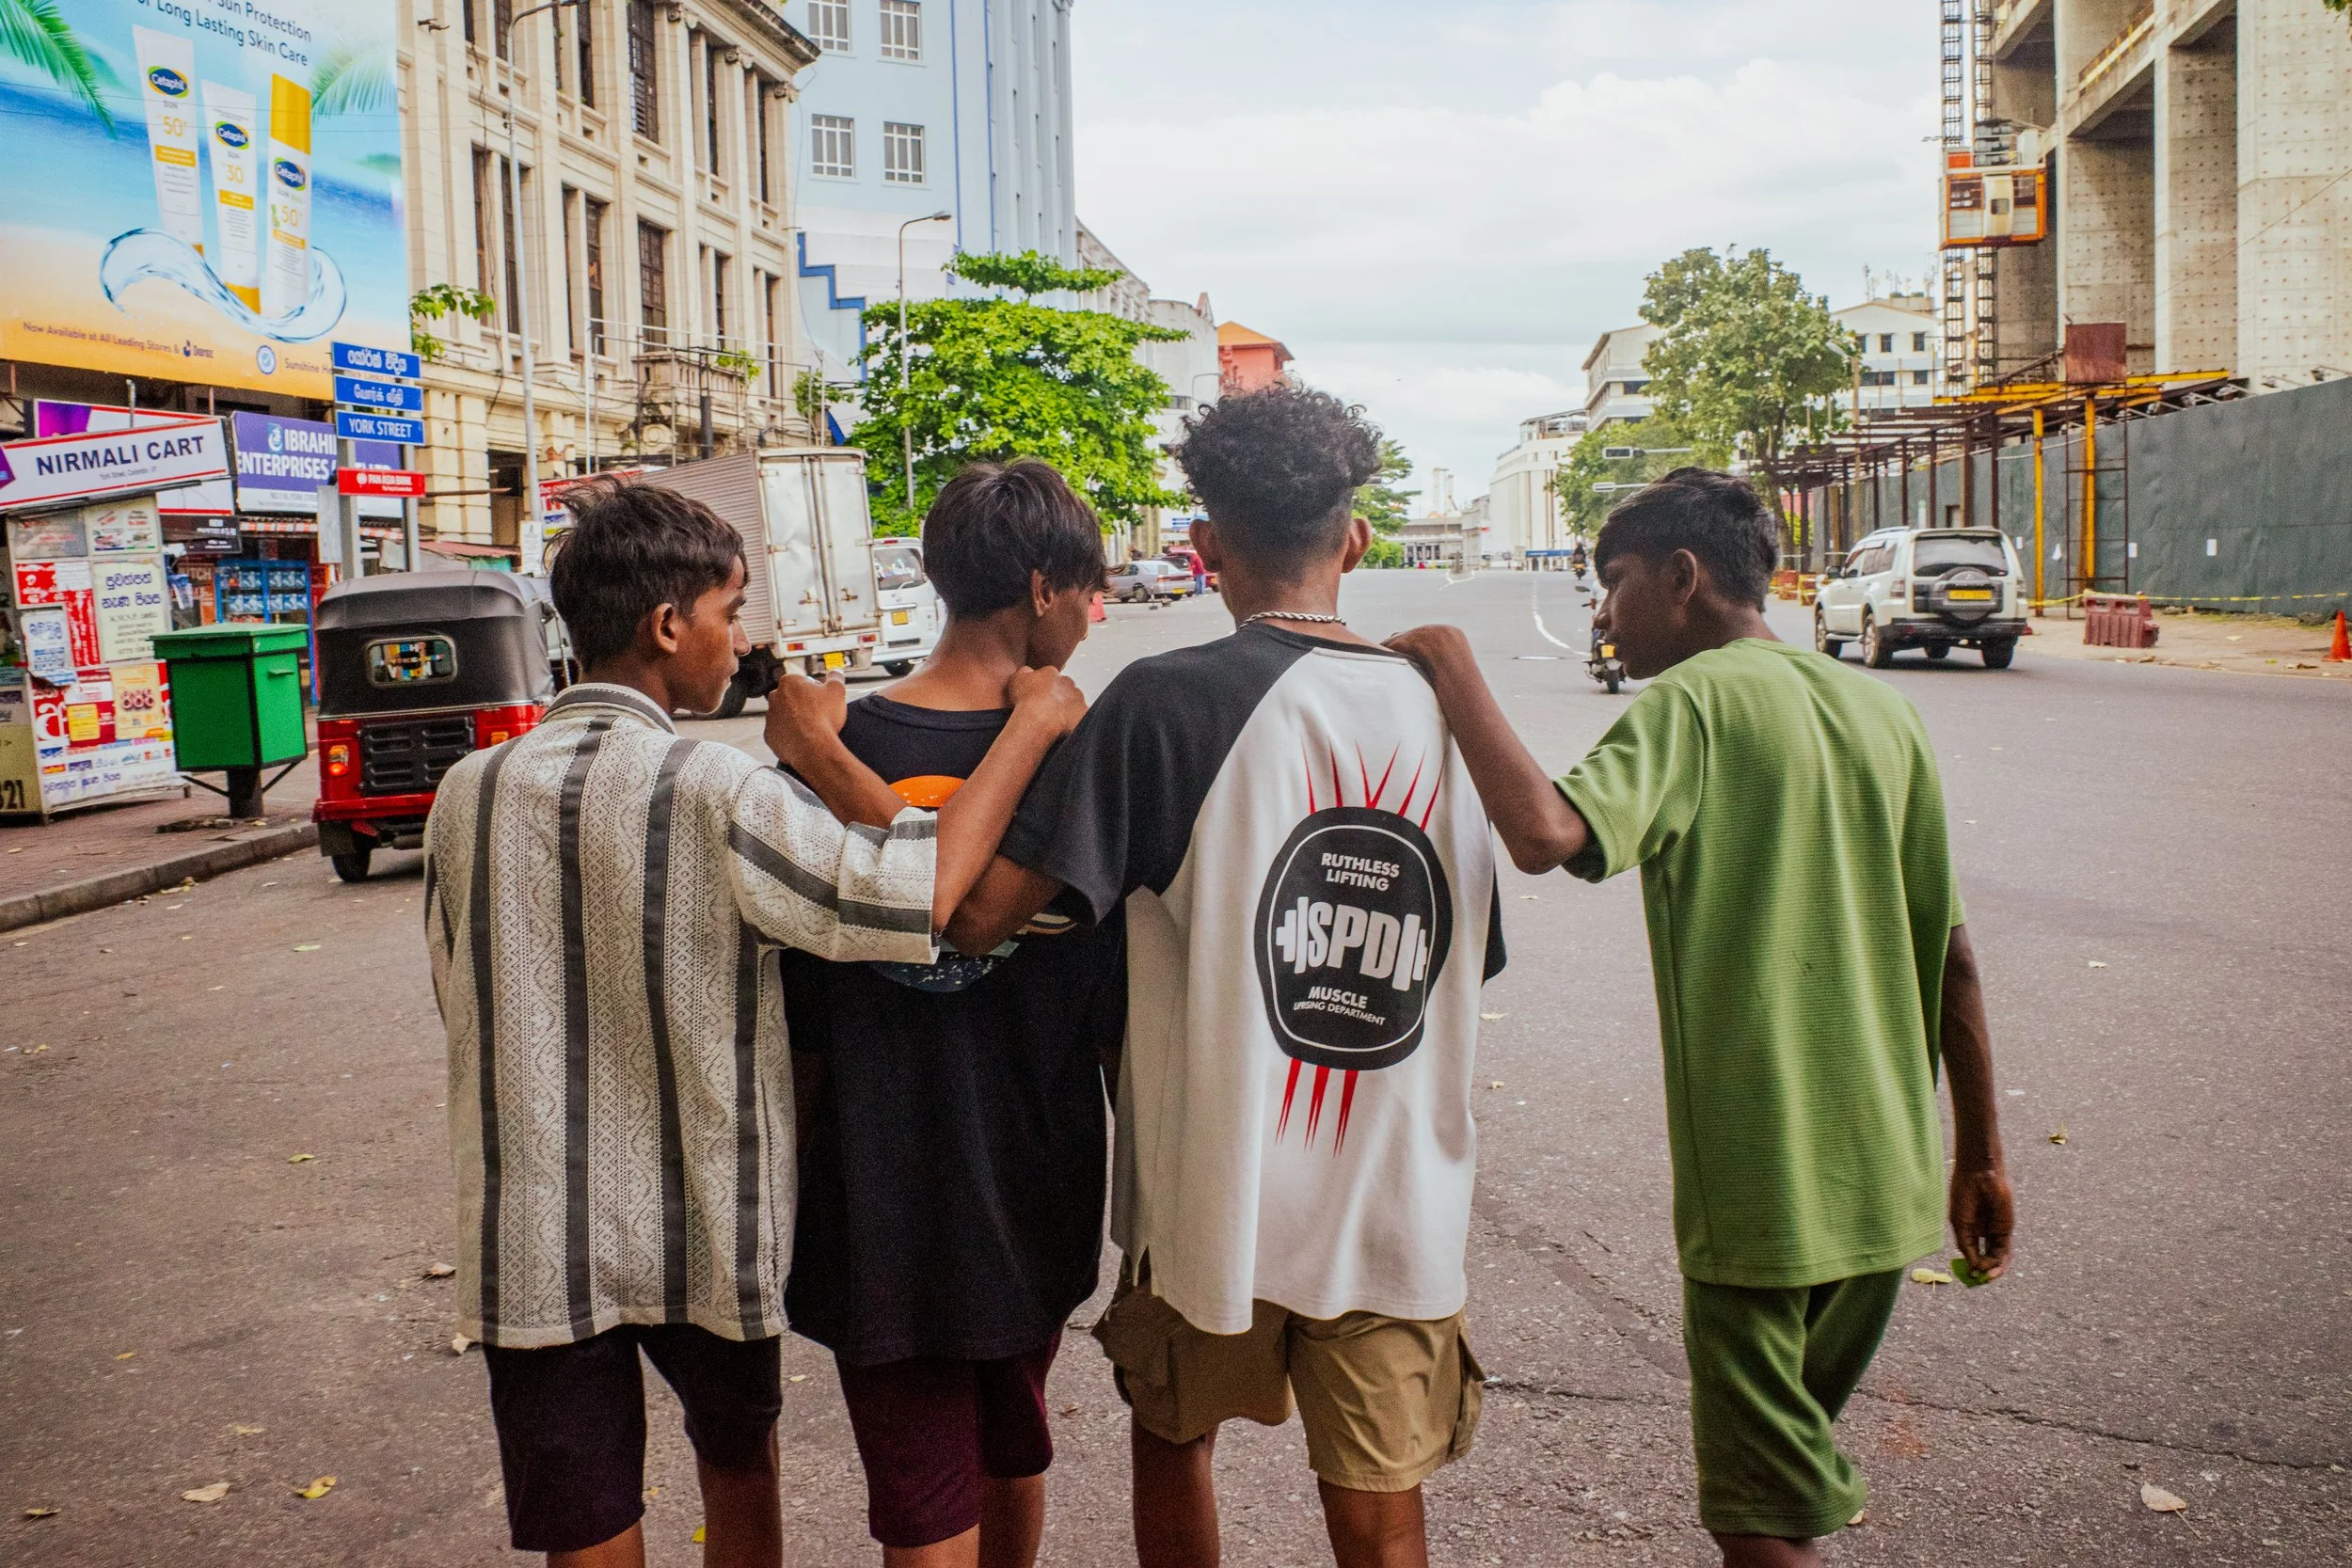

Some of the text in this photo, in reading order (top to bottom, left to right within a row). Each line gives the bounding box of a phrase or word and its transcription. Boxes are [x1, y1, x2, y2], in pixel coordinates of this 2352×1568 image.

[157, 0, 309, 66] Long Lasting Skin Care
[246, 2, 311, 42] Protection
[151, 72, 186, 91] Cetaphil
[227, 165, 244, 183] 30
[23, 321, 44, 333] Now
[47, 325, 87, 340] Available
[88, 332, 98, 341] at
[100, 332, 111, 343] All
[113, 334, 145, 352] Leading
[147, 339, 171, 353] Stores
[284, 357, 322, 372] Sunshine
[348, 418, 412, 438] YORK STREET
[284, 429, 337, 456] IBRAHI
[36, 436, 204, 476] NIRMALI CART
[237, 451, 329, 481] ENTERPRISES
[0, 779, 24, 809] 21
[1321, 852, 1400, 878] RUTHLESS
[1326, 868, 1390, 891] LIFTING
[1308, 986, 1368, 1009] MUSCLE
[1327, 1003, 1386, 1025] DEPARTMENT
